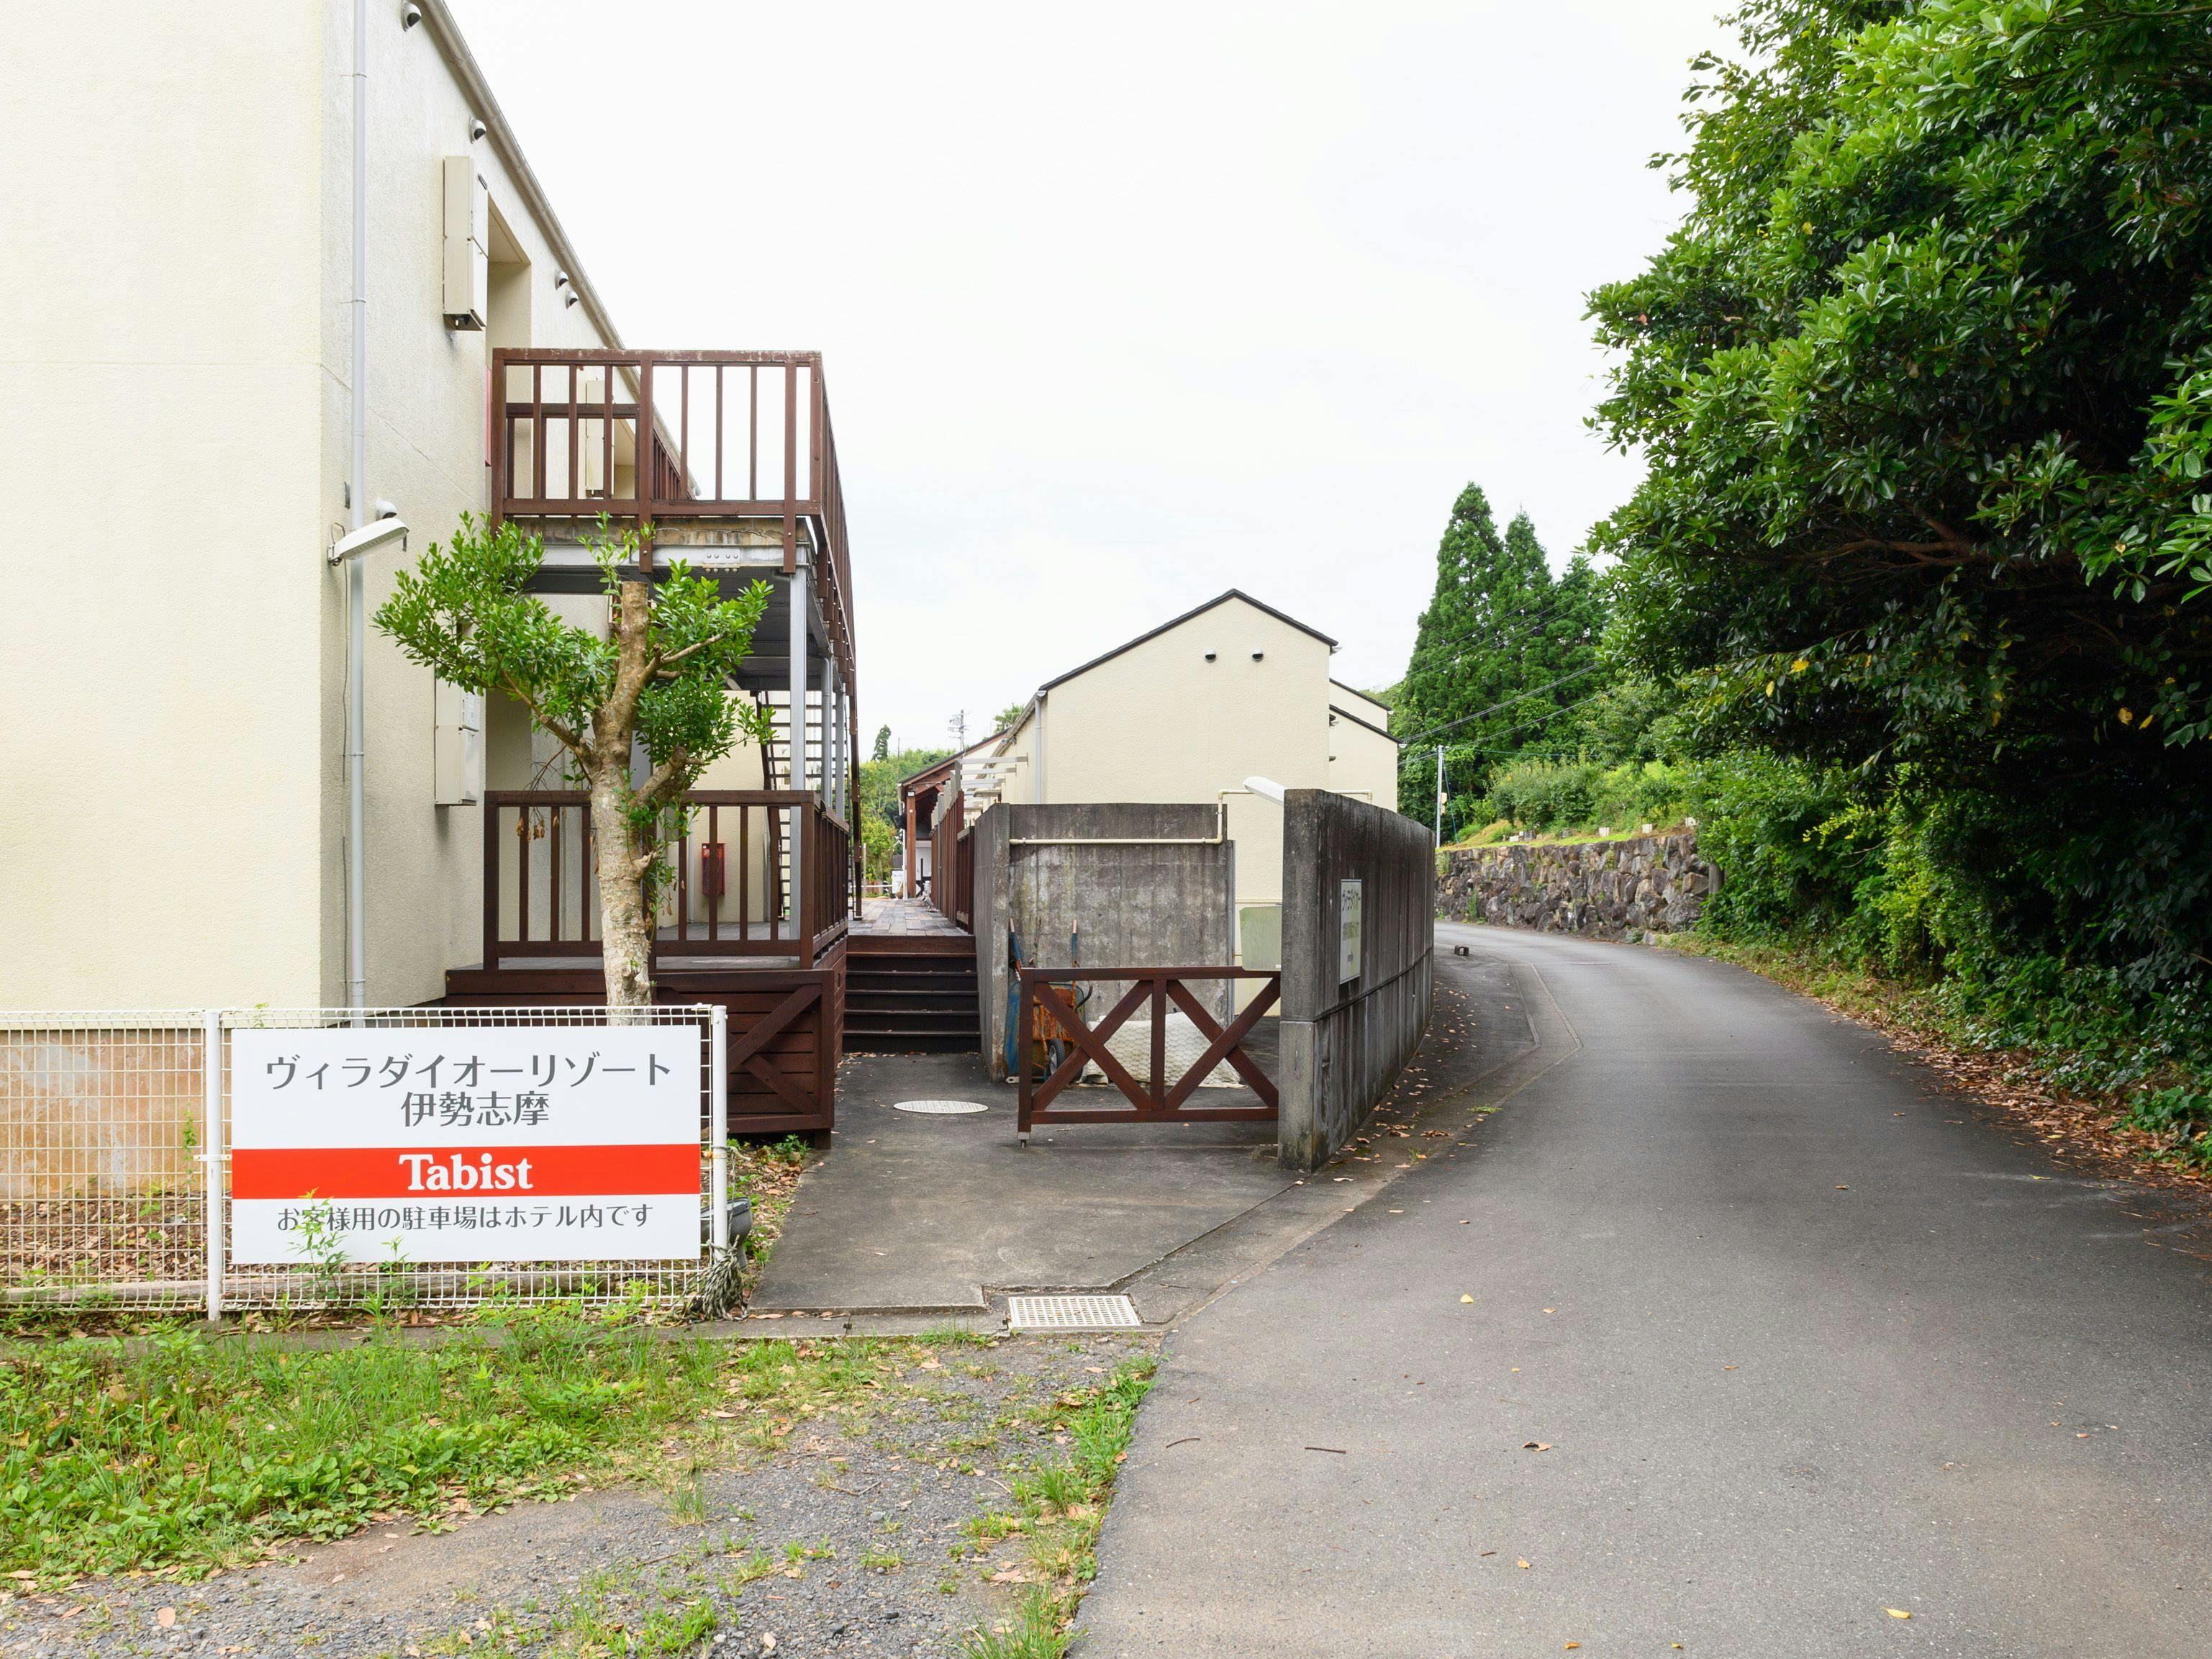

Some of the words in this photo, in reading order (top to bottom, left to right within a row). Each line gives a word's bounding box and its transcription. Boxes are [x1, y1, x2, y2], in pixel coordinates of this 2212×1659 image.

[266, 1052, 671, 1090] ヴィラダイオーリゾート
[401, 1090, 549, 1126] 伊勢志摩
[399, 1153, 533, 1190] Tabist
